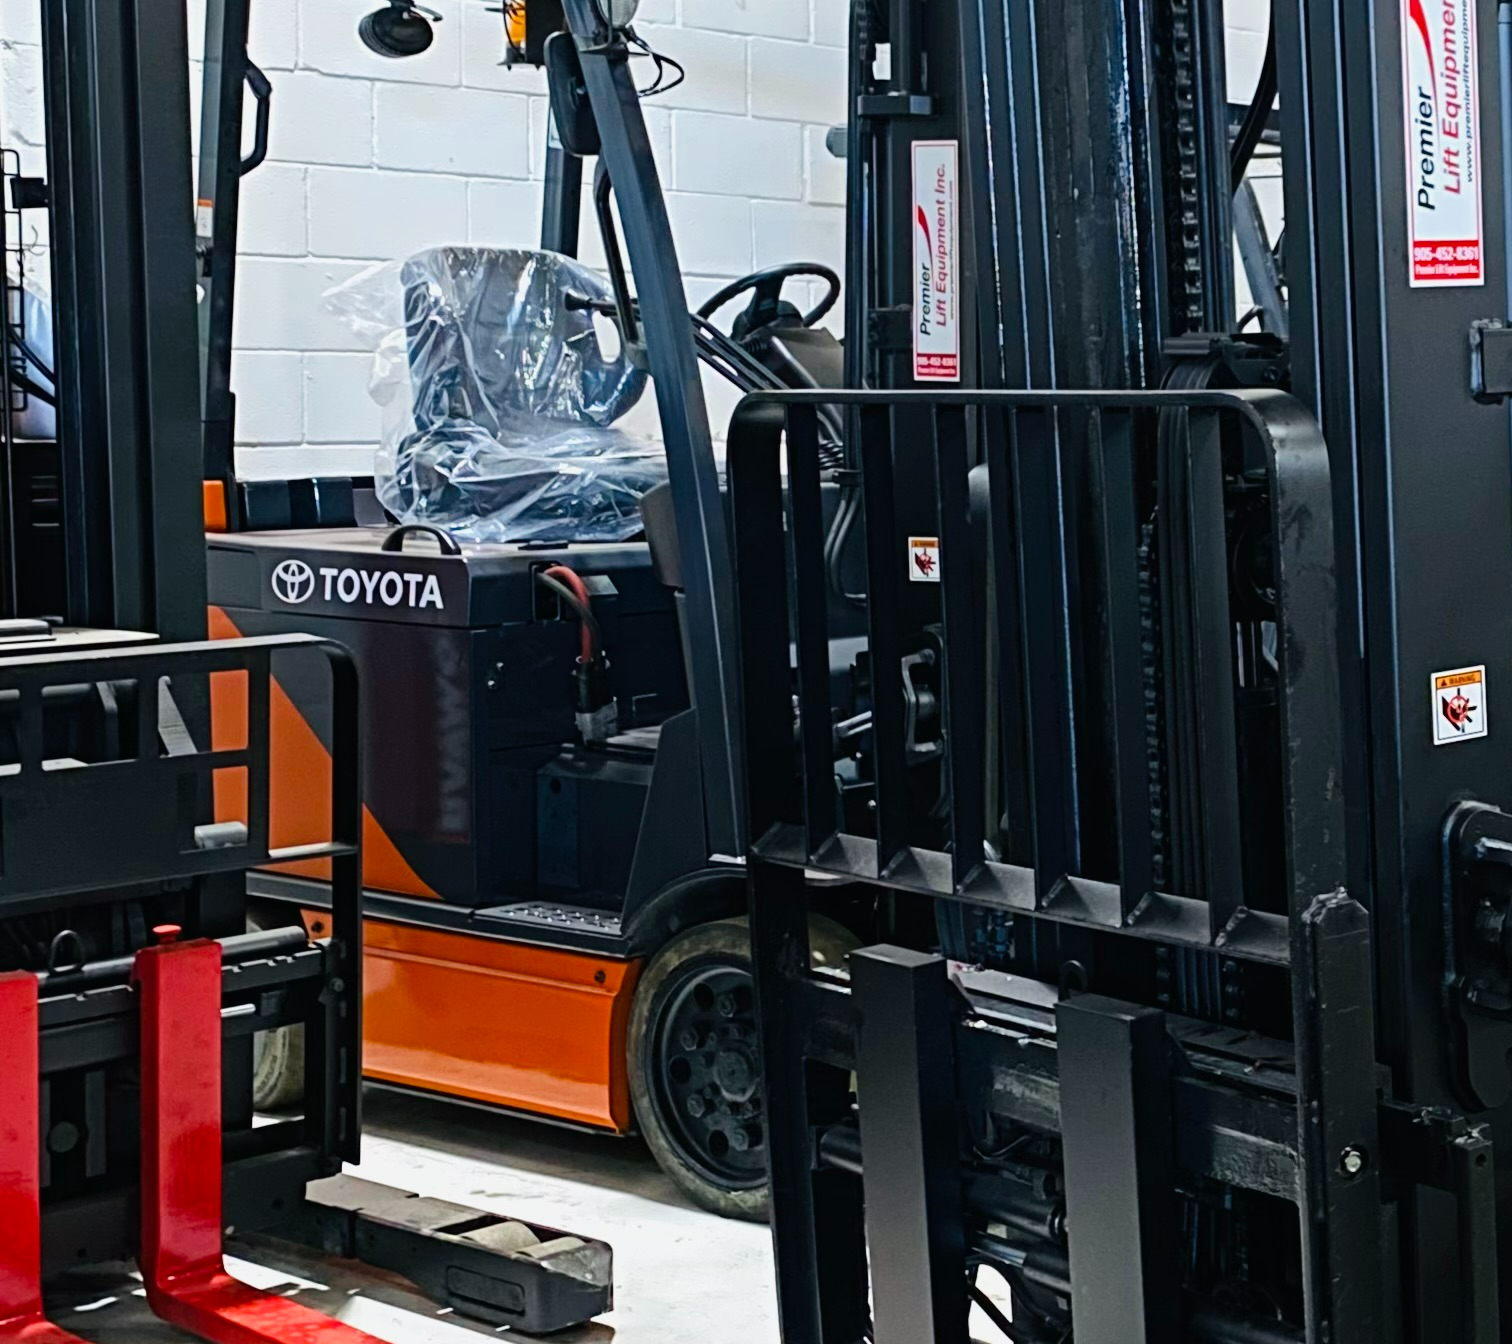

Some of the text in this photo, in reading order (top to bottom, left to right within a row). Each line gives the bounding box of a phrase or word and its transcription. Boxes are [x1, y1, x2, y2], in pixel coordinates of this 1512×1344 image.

[1415, 85, 1436, 211] Premier
[1443, 146, 1461, 195] Lift
[934, 163, 949, 327] Lift Equipment Inc.
[919, 262, 932, 336] Premier
[319, 567, 445, 610] TOYOTA
